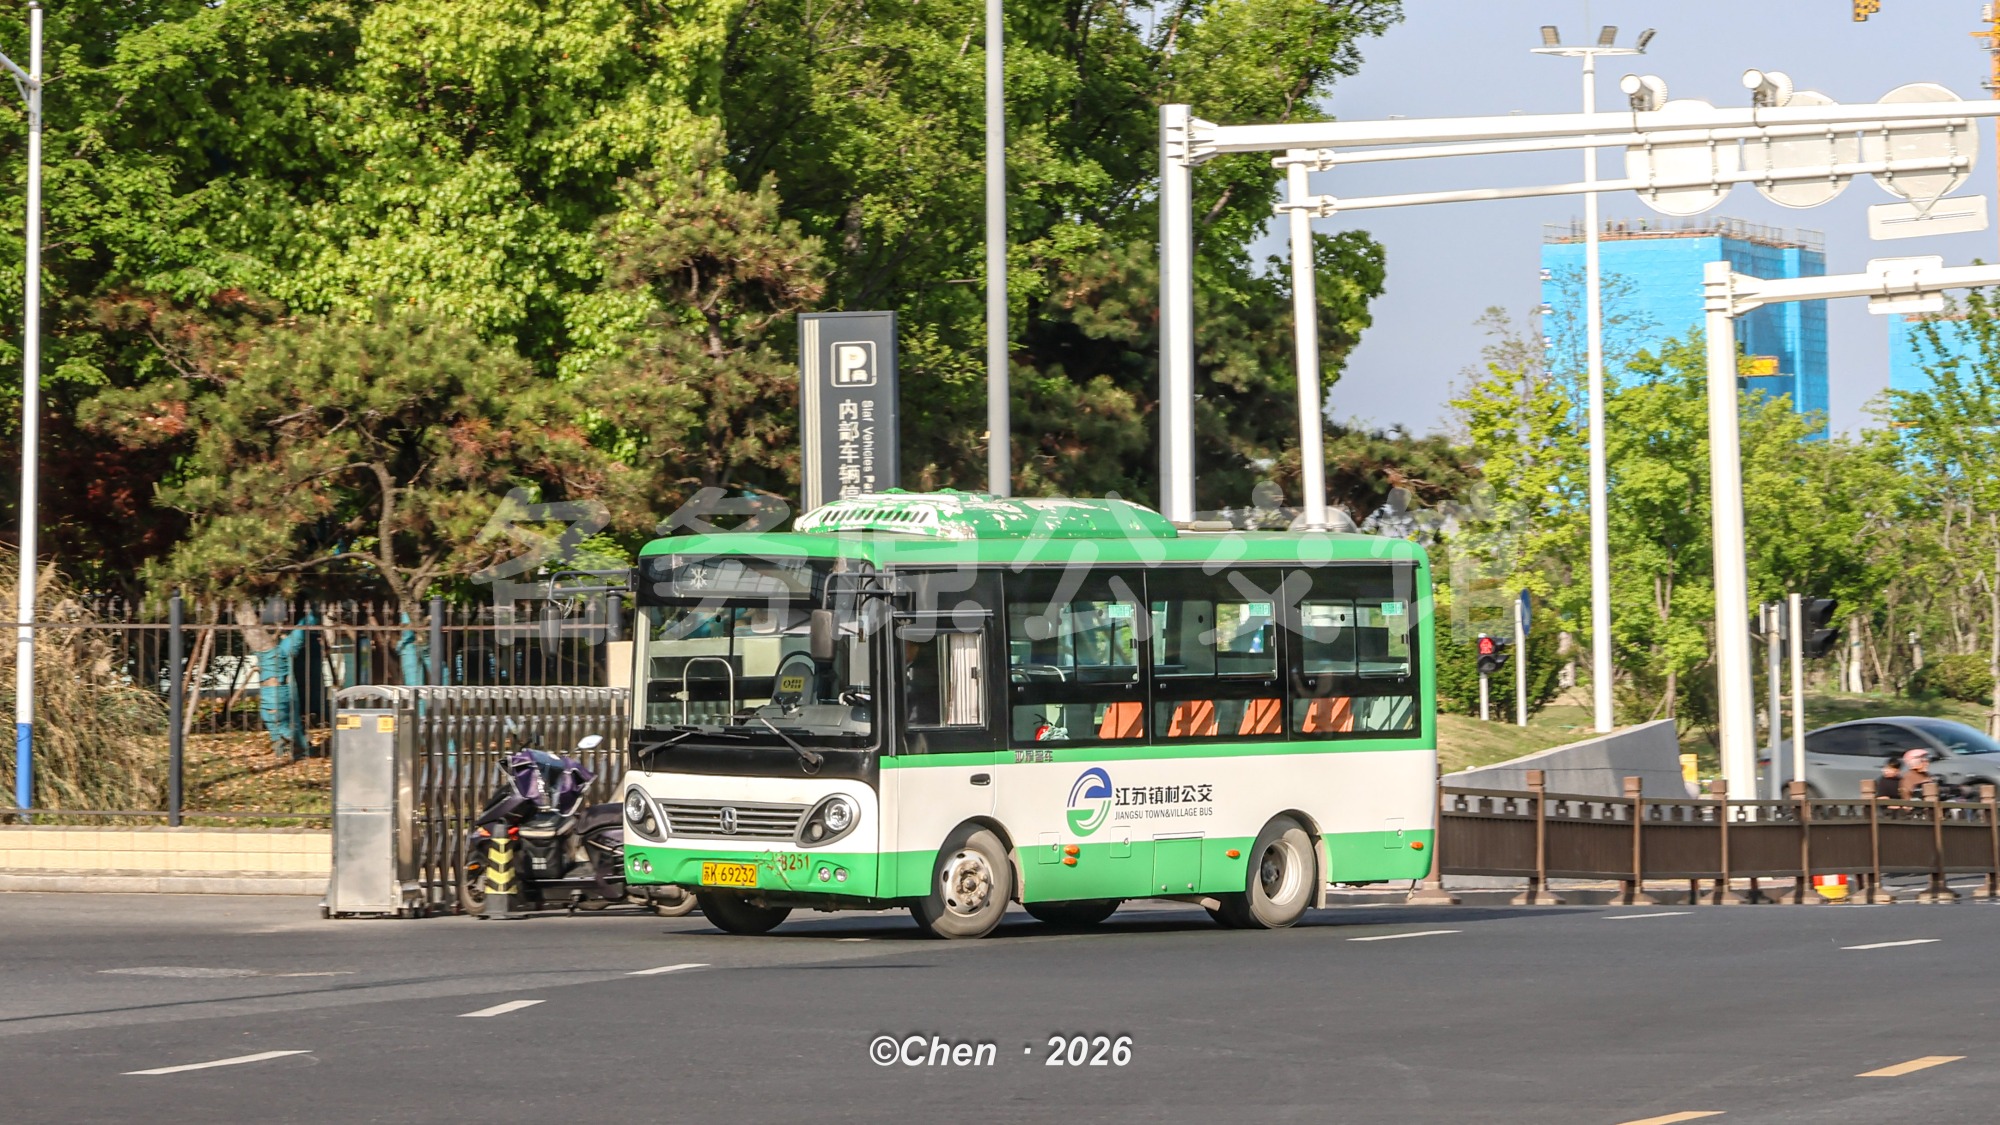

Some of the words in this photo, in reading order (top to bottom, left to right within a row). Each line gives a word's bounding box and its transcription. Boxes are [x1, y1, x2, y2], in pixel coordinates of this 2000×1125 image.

[862, 426, 875, 473] Vehicles
[1115, 784, 1213, 806] 江苏镇村公交
[1115, 810, 1143, 820] JIANGSU
[1145, 807, 1198, 819] TOWN&VILLAGE
[1199, 807, 1213, 816] BUS
